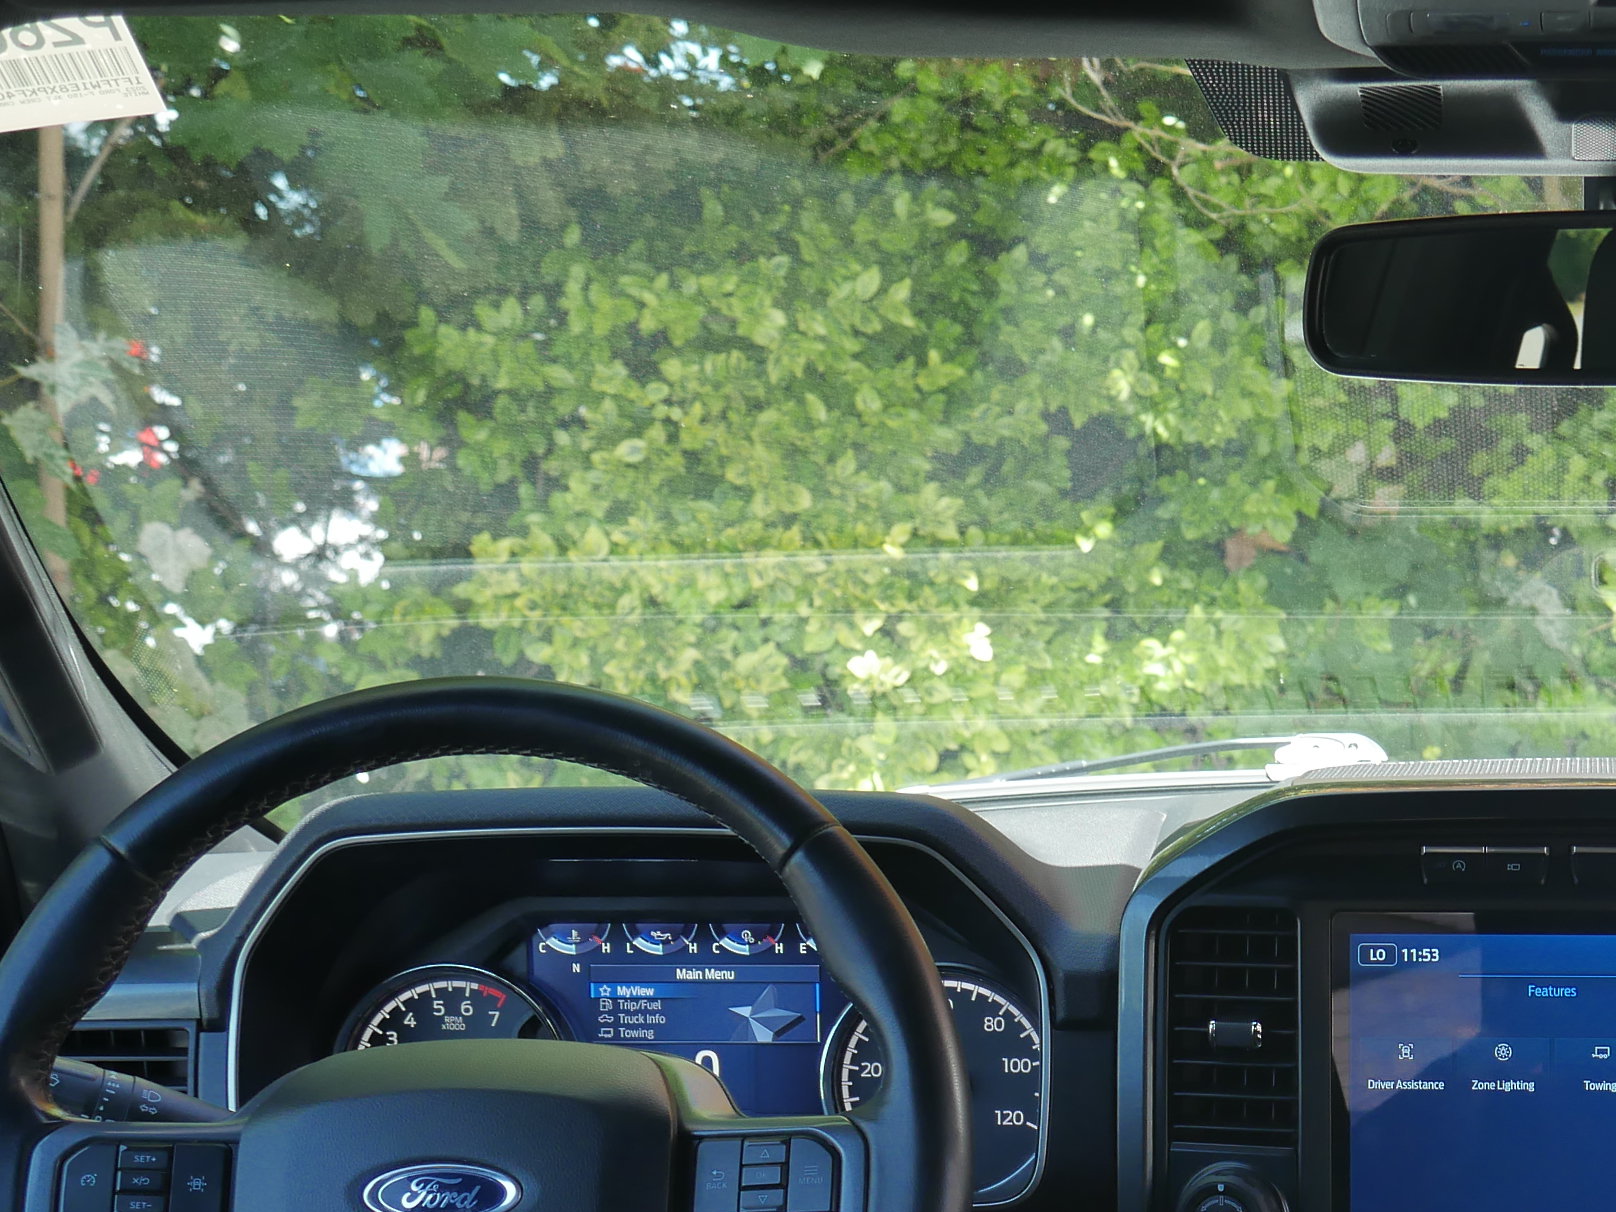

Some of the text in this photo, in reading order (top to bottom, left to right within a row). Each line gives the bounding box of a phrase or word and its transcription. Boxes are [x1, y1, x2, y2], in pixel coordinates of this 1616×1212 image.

[538, 942, 546, 954] C
[602, 942, 610, 954] H
[627, 942, 634, 954] L
[689, 942, 697, 954] H
[712, 942, 720, 954] C
[775, 942, 783, 954] H
[800, 942, 807, 954] E
[1369, 948, 1387, 962] LO
[1401, 948, 1440, 963] 11:53
[572, 962, 581, 973] N
[676, 968, 735, 980] Main Menu
[616, 985, 655, 998] MyView
[1528, 984, 1577, 998] Features
[433, 1001, 446, 1016] 5
[460, 1001, 473, 1016] 6
[617, 999, 662, 1012] Trip/Fuel
[403, 1012, 417, 1028] 4
[444, 1016, 463, 1024] RPM
[488, 1011, 500, 1027] 7
[618, 1014, 666, 1025] Truck Info
[983, 1016, 1005, 1032] 80
[386, 1031, 398, 1046] 3
[618, 1027, 655, 1040] Towing
[860, 1062, 883, 1078] 20
[1001, 1057, 1032, 1074] 100
[1368, 1079, 1445, 1091] Driver Assistance
[1471, 1079, 1535, 1093] Zone Lighting
[994, 1110, 1024, 1126] 120
[705, 1182, 728, 1190] BACK
[798, 1176, 824, 1185] MENU
[401, 1176, 482, 1209] Ford
